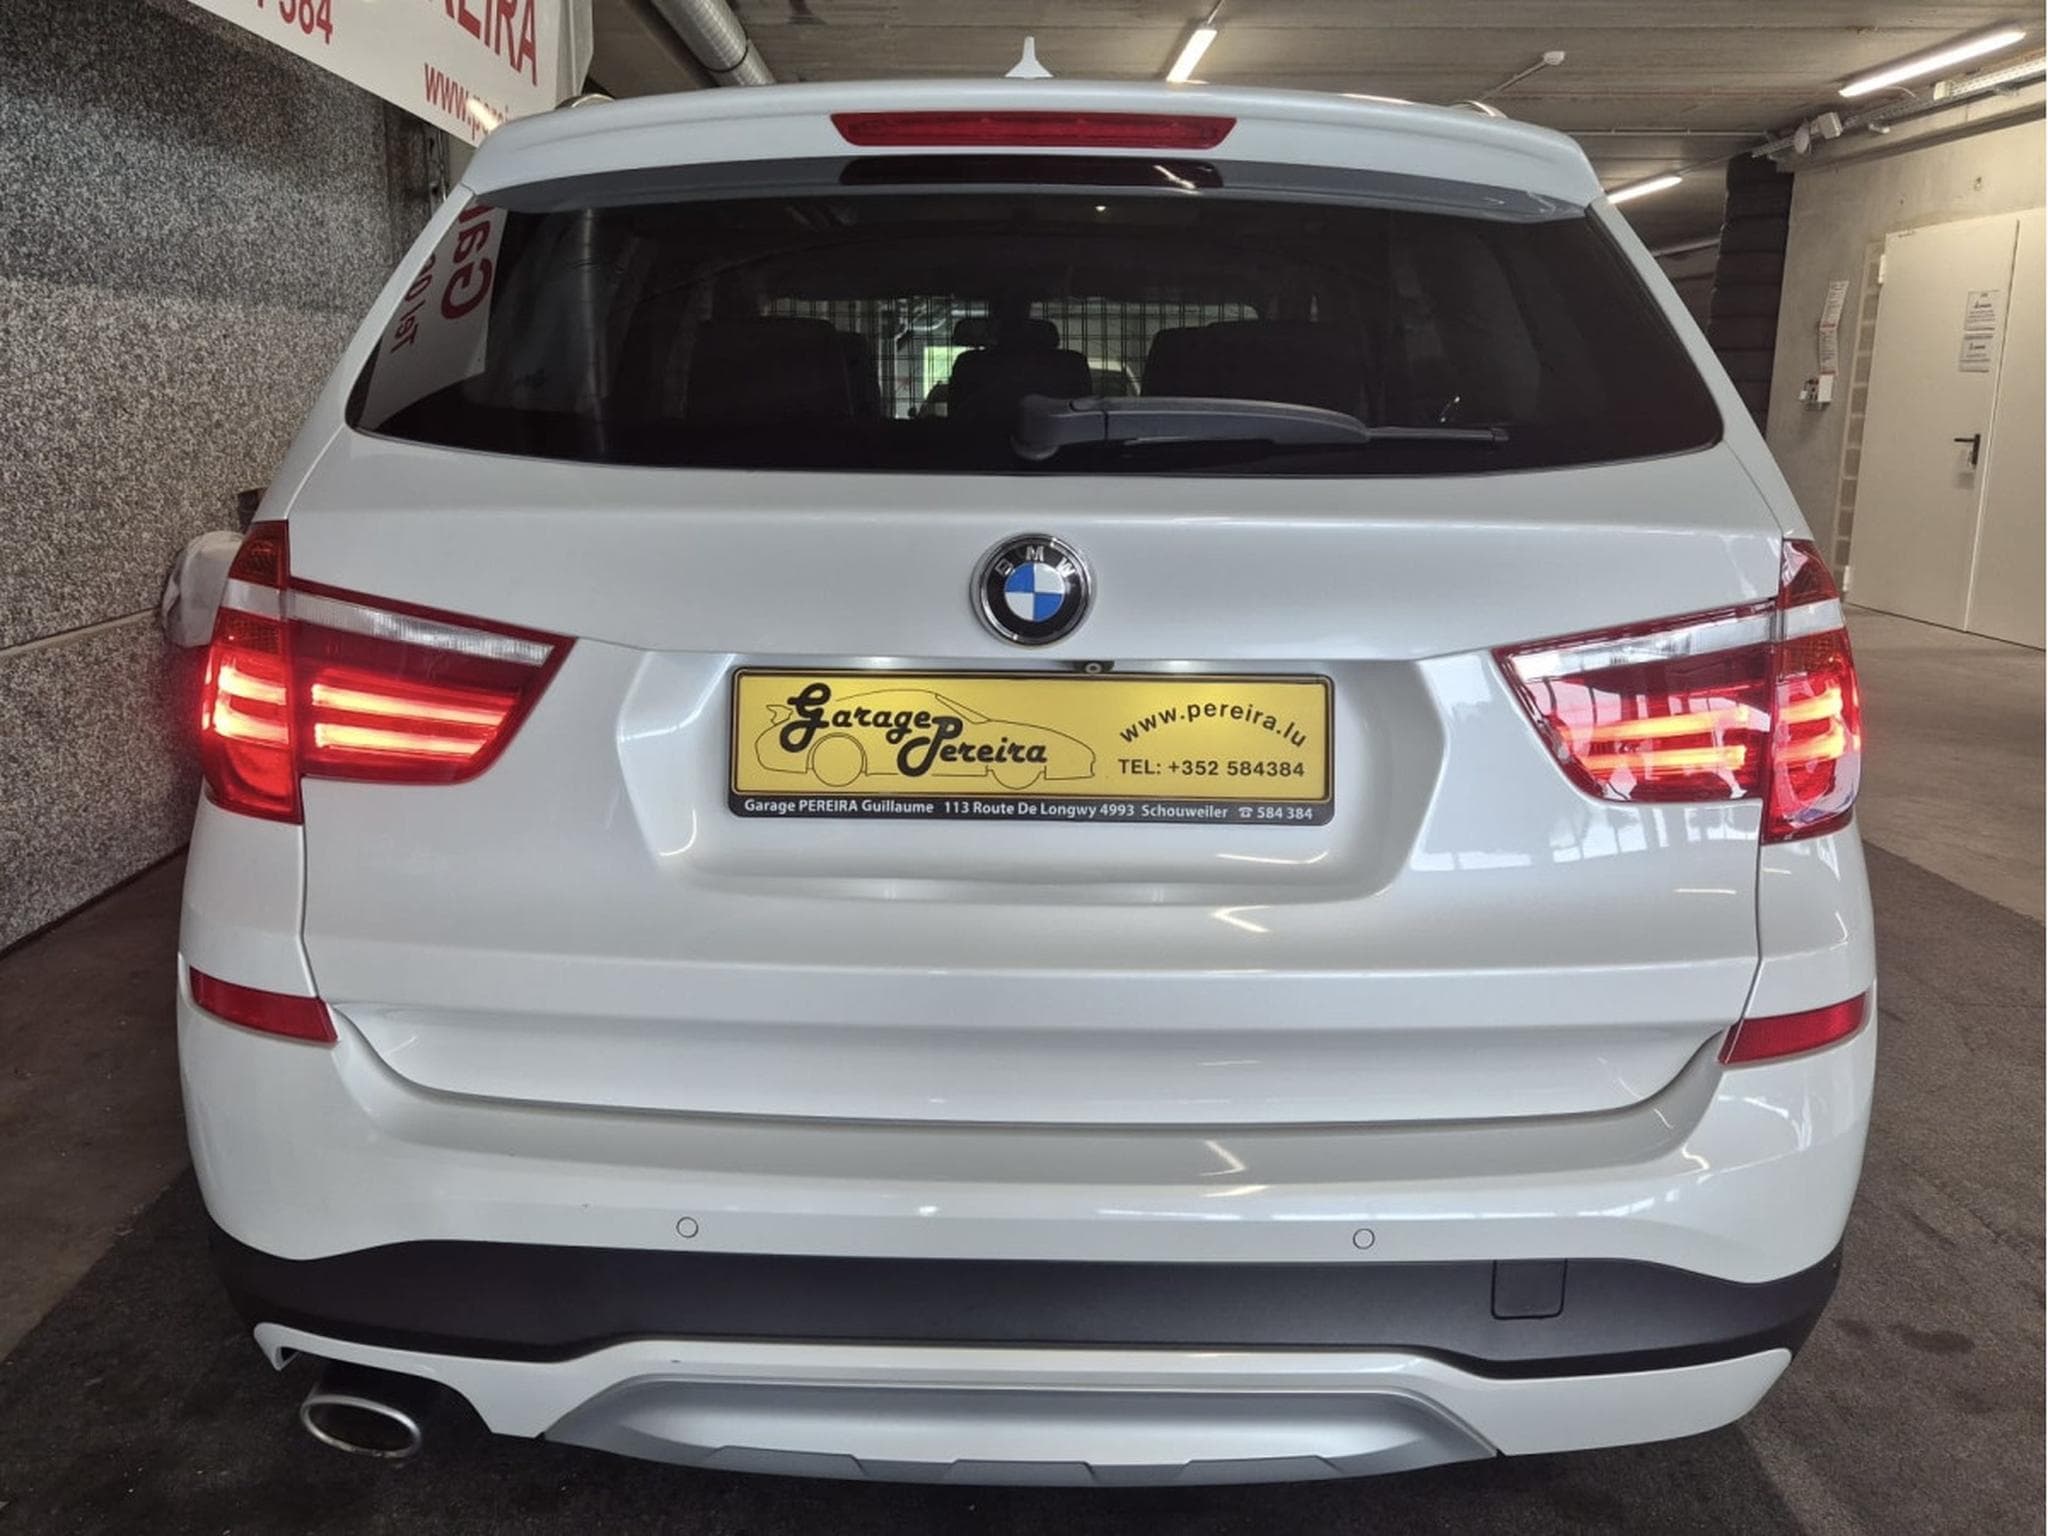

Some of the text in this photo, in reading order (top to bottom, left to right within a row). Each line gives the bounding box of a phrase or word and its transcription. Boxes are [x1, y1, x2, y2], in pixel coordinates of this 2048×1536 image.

[995, 545, 1076, 578] BMW
[779, 682, 932, 753] Garage
[1120, 702, 1307, 747] www.pereira.lu
[897, 716, 1048, 777] Pereira
[1118, 758, 1305, 777] TEL: +352 584384
[744, 799, 1313, 820] Garage PEREIRA Guillaume 113 Route De Longwy 4993 Schouweiler 584 384
